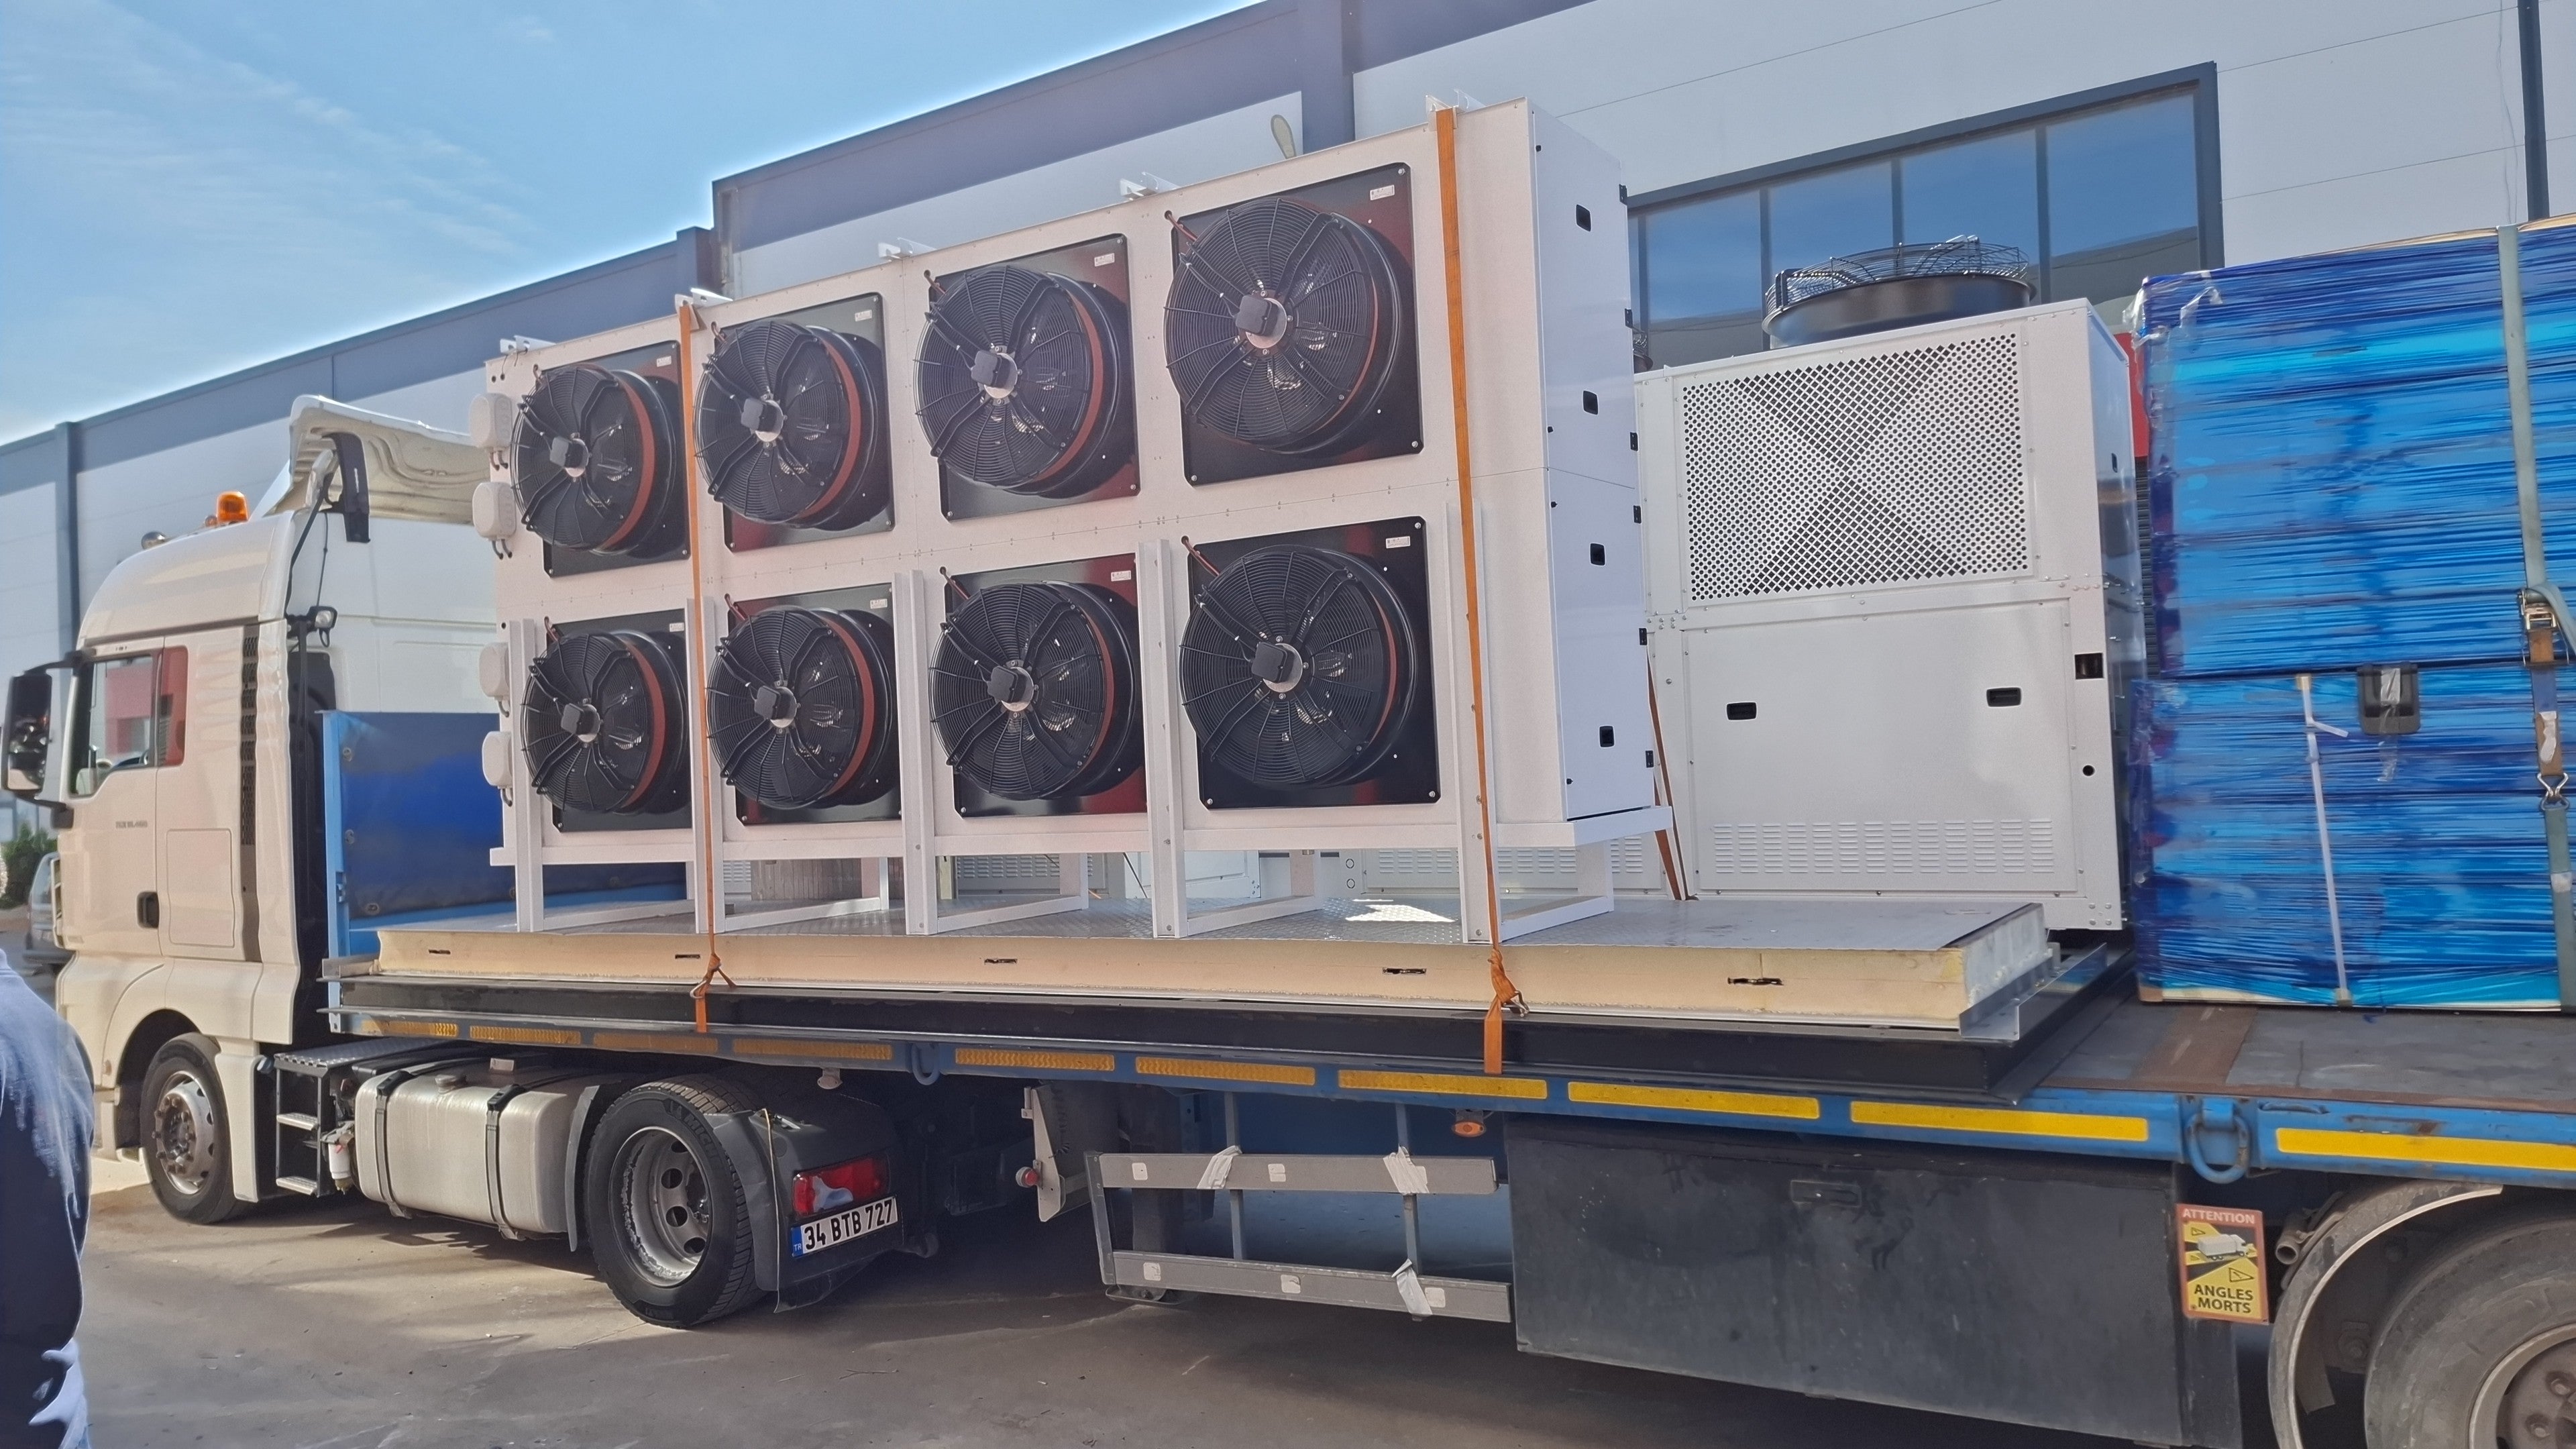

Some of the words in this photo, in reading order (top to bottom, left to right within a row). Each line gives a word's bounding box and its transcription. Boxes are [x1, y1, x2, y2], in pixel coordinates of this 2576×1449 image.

[2183, 1208, 2255, 1224] ATTENTION
[804, 1223, 826, 1250] 34
[830, 1211, 861, 1242] BTB
[865, 1199, 892, 1230] 727
[794, 1242, 802, 1251] TR
[2194, 1284, 2253, 1301] ANGLES
[2198, 1297, 2251, 1313] MORTS
